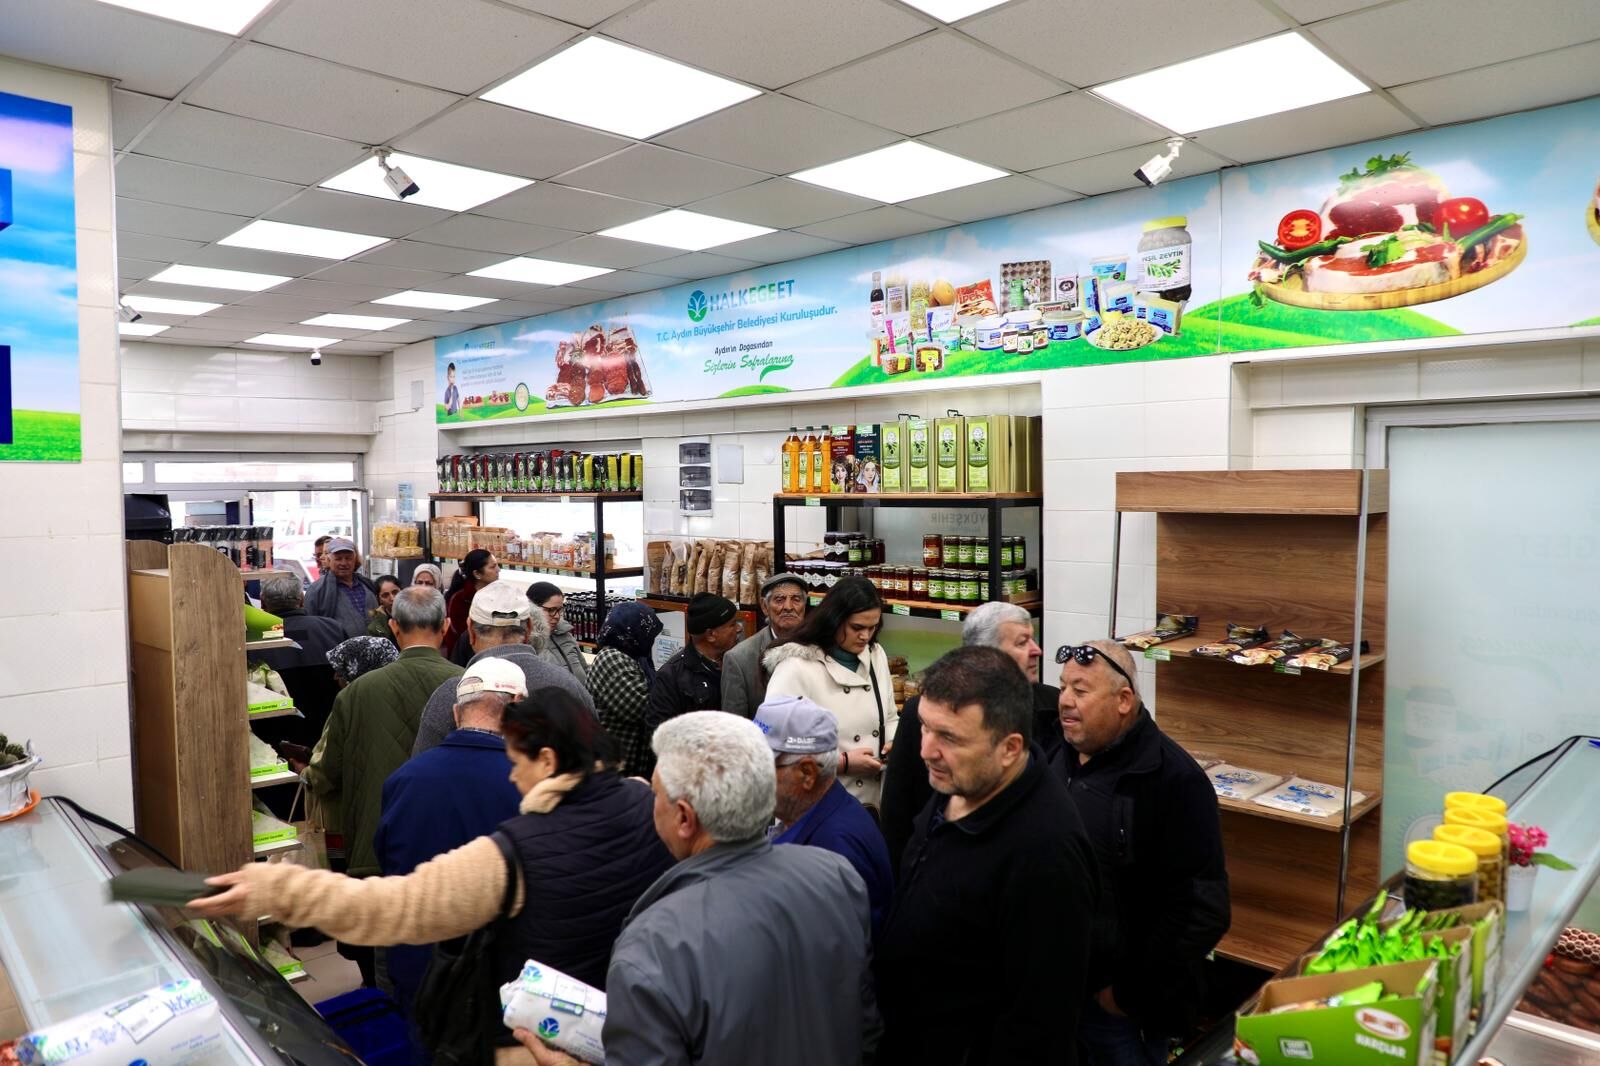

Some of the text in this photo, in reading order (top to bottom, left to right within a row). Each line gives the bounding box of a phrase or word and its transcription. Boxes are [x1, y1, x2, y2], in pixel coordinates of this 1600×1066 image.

[709, 279, 795, 312] HALKEGEET
[656, 305, 838, 342] T.C. Aydın Büyükşehir Belediyesi Kuruluşudur.
[703, 353, 794, 375] Sizlerin Sofralarına
